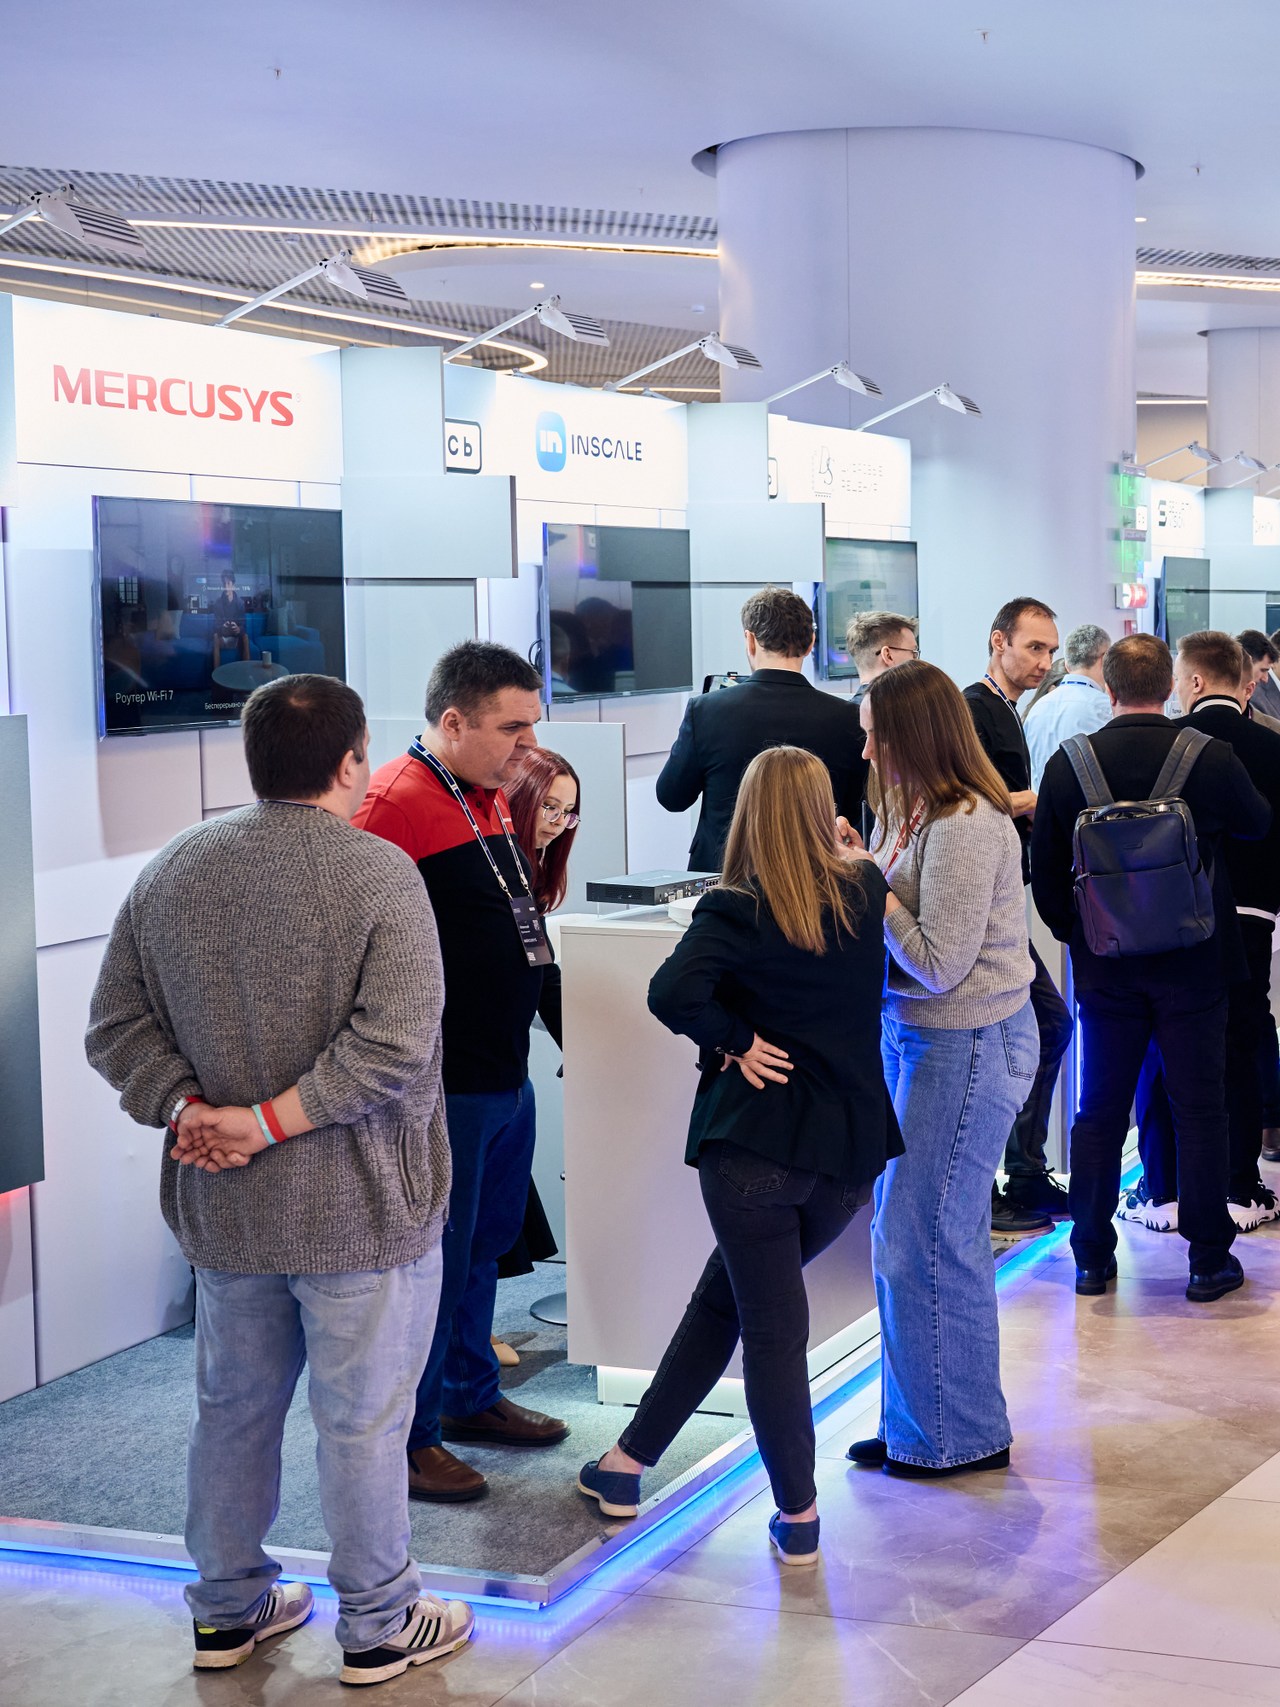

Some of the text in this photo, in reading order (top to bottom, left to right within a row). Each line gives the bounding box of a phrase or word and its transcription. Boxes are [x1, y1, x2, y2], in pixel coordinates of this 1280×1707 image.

[53, 364, 294, 427] MERCUSYS
[571, 434, 643, 461] INSCALE
[115, 690, 174, 705] Роутер Wi-Fi 7
